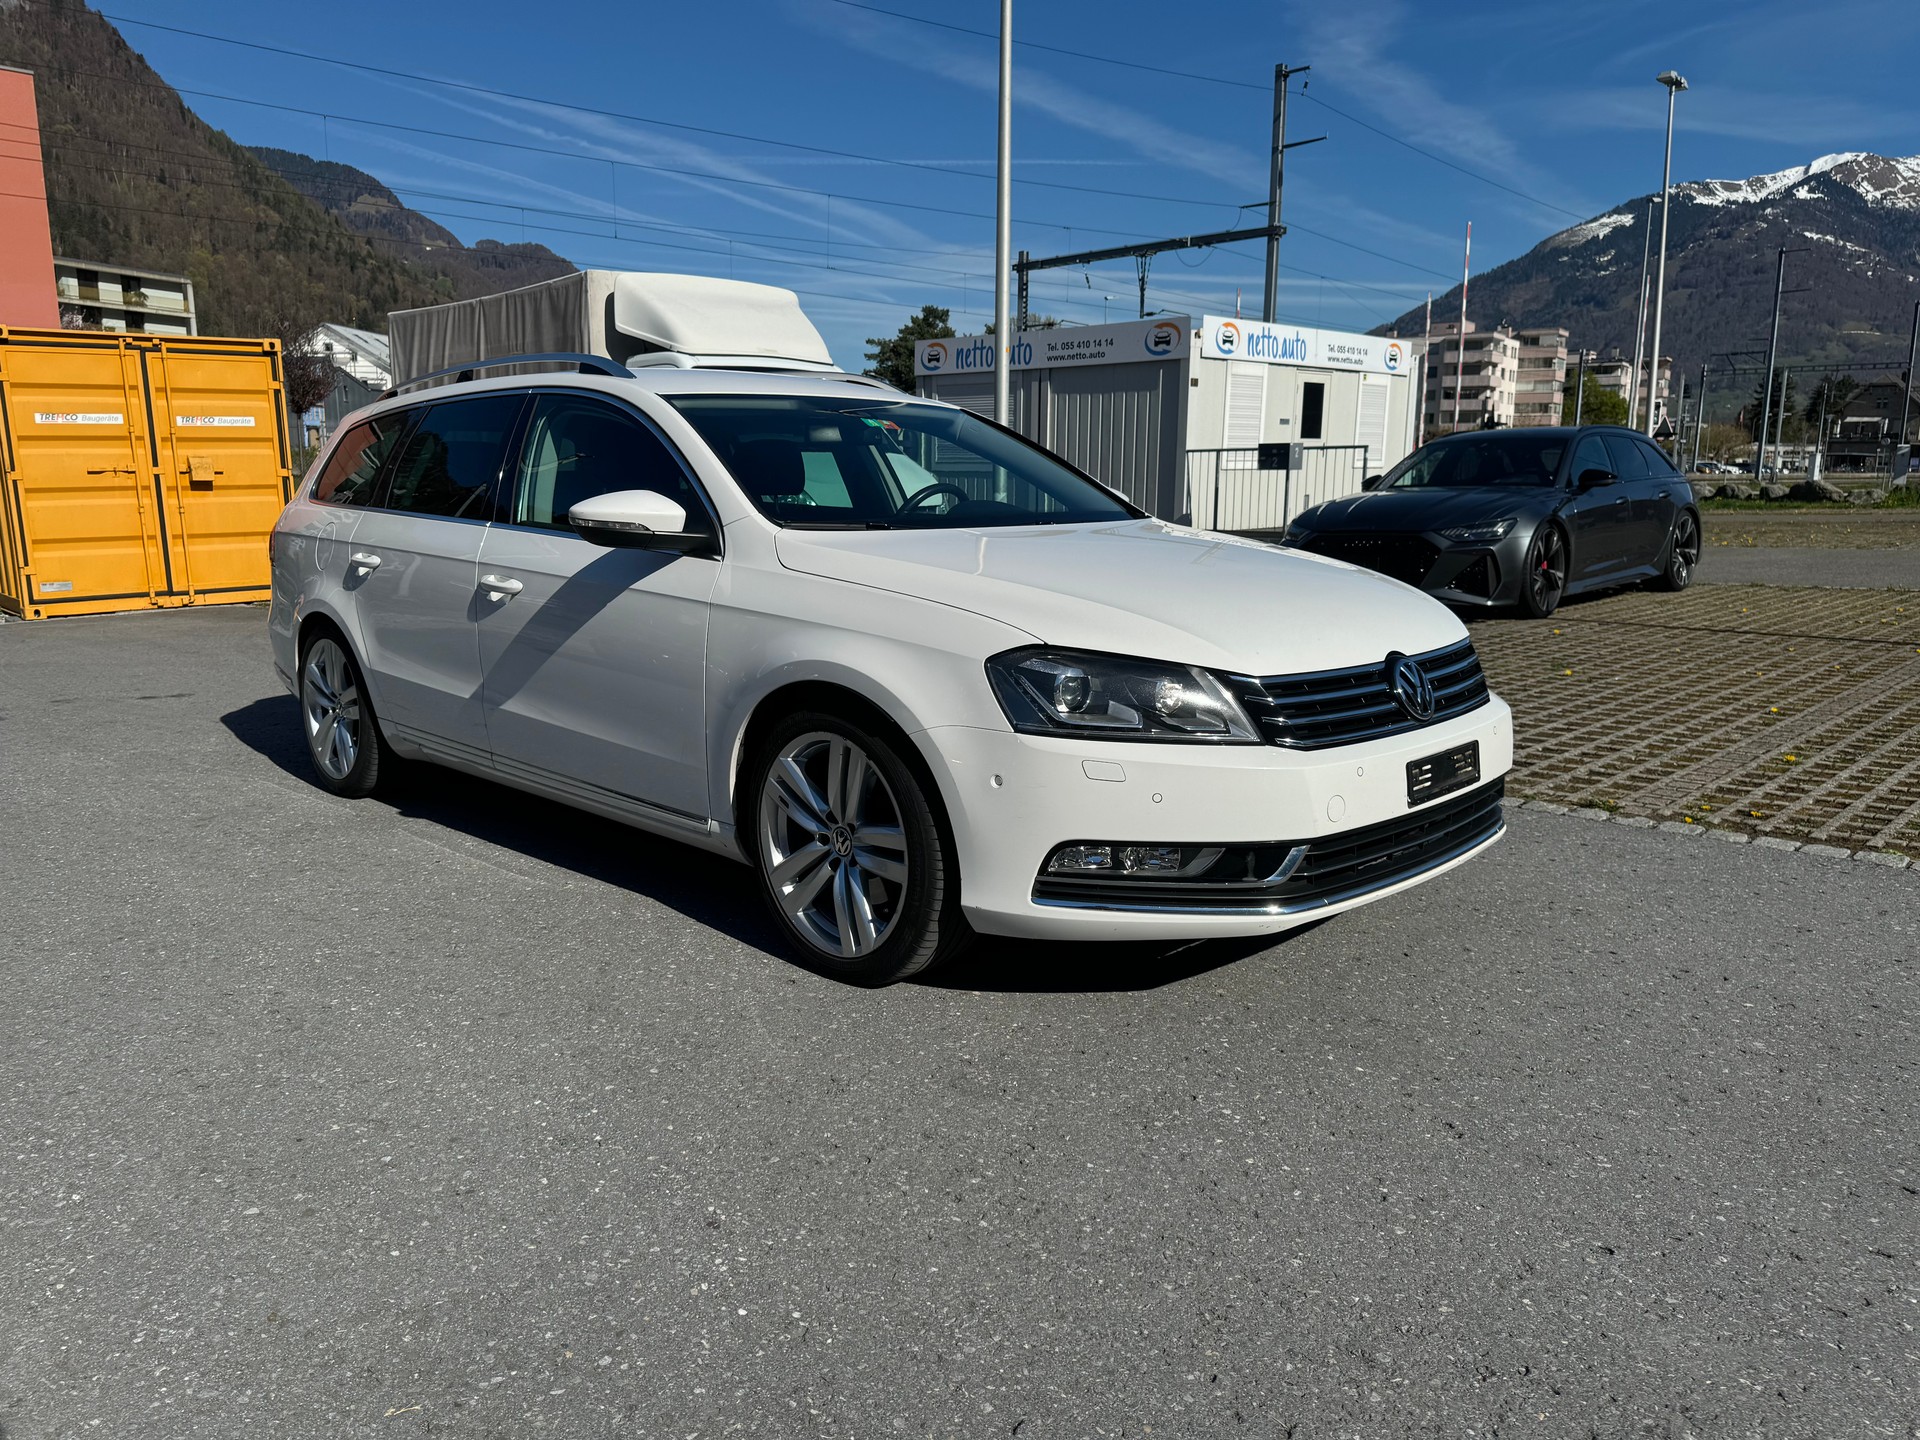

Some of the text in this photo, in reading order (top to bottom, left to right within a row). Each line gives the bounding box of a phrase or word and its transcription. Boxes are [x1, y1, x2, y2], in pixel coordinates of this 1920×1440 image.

[1046, 338, 1114, 352] Tel. 055 410 14 14
[1248, 326, 1306, 362] netto.auto
[1328, 344, 1336, 353] Tel.
[1336, 346, 1346, 354] 055
[956, 336, 1032, 369] nettouto
[1046, 351, 1106, 362] www.netto.auto
[1327, 356, 1363, 365] www.netto.auto
[40, 413, 78, 422] TREMCO
[181, 416, 216, 424] TREMCO
[1294, 447, 1299, 458] 2
[1272, 457, 1278, 468] 2
